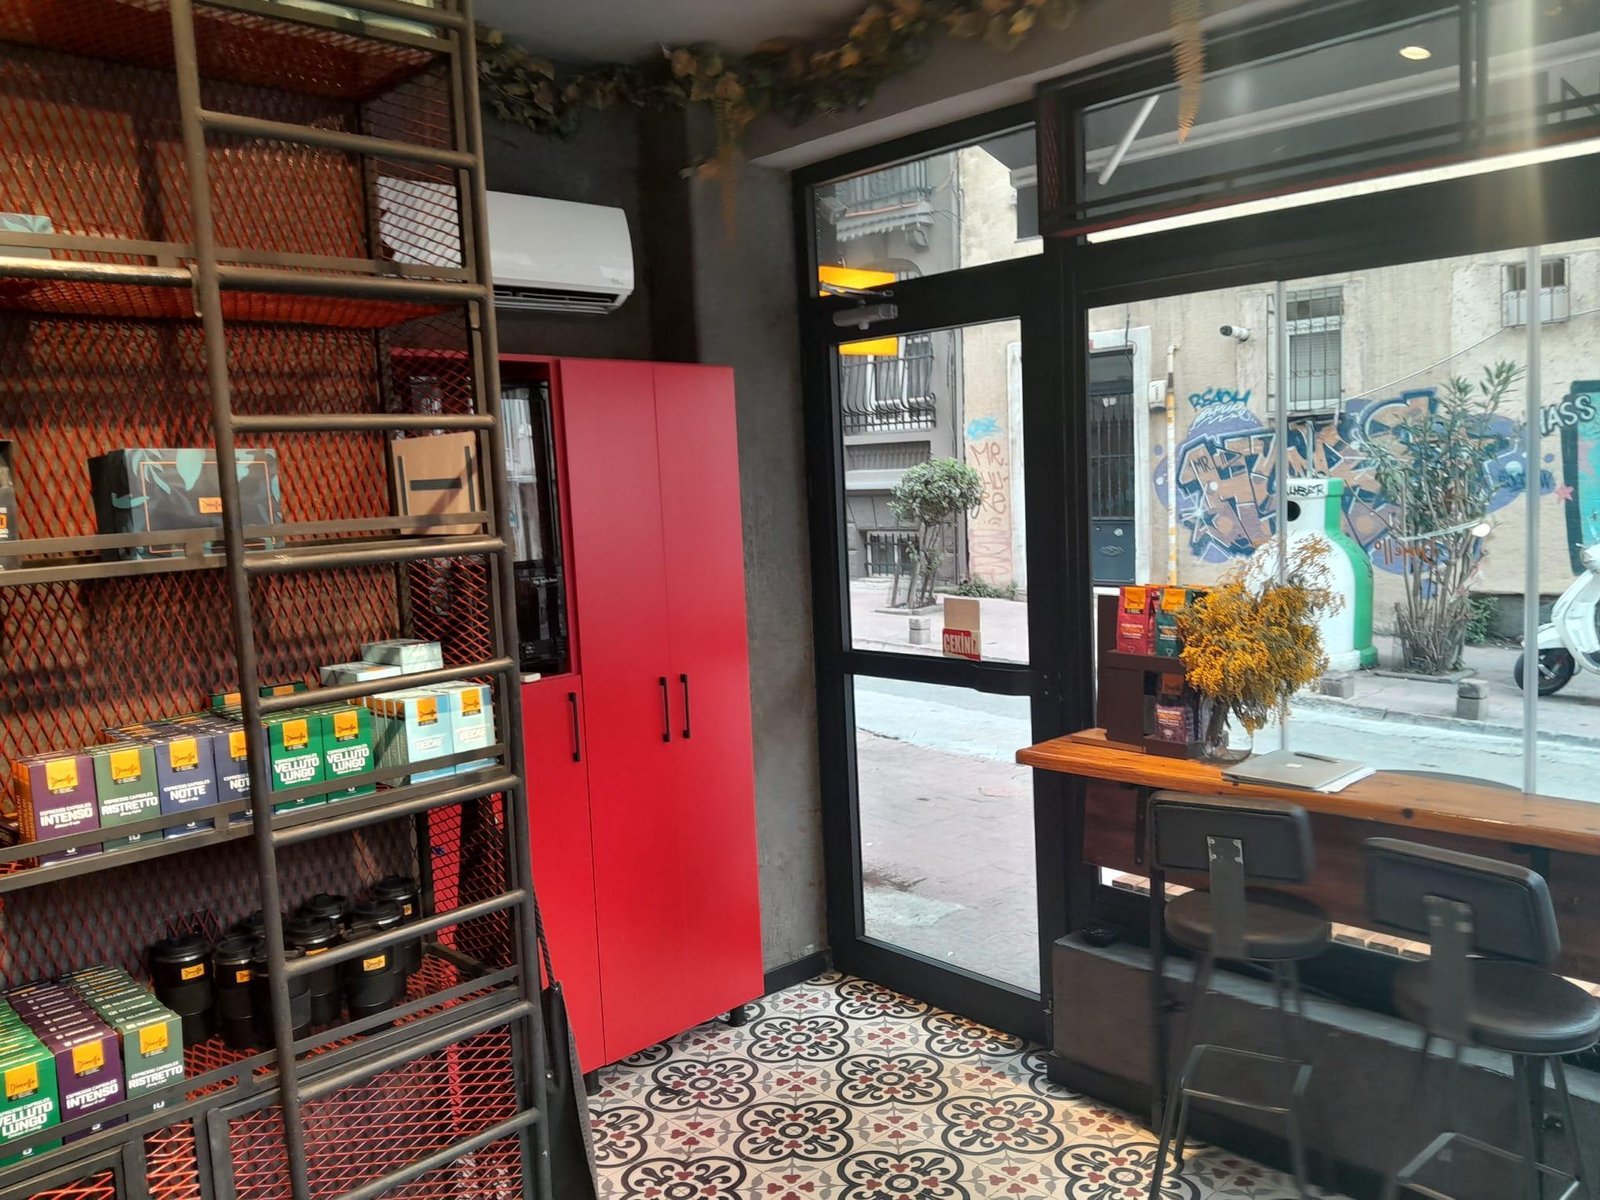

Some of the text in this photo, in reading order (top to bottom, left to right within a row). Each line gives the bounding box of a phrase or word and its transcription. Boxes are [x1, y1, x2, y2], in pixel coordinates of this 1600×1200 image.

[326, 748, 369, 764] VELLUTO
[333, 757, 366, 772] LUNGO
[274, 757, 320, 774] VELLUTO
[281, 766, 315, 782] LUNGO
[230, 777, 250, 790] NOT
[170, 785, 207, 801] NOTTE
[101, 797, 159, 816] RISTRETTO
[40, 807, 93, 827] INTENSO
[128, 1065, 183, 1089] RISTRETTO
[66, 1083, 118, 1109] INTENSO
[2, 1113, 47, 1137] LUNGO
